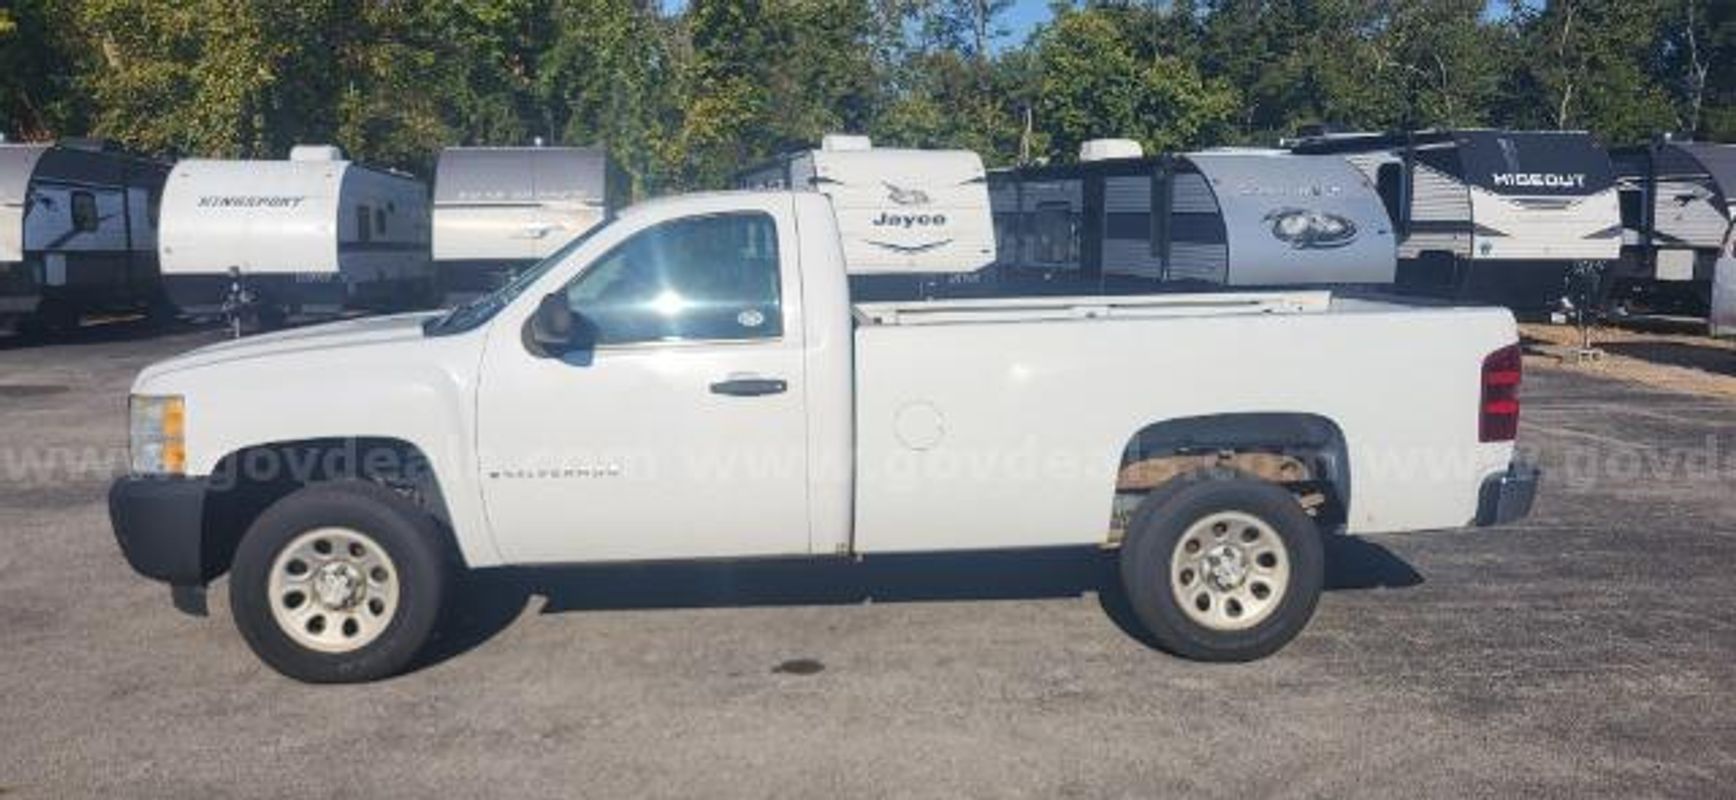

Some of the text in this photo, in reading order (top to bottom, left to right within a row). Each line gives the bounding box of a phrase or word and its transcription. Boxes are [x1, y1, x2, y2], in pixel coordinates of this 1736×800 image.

[1492, 173, 1586, 187] HIDEOUT
[198, 194, 304, 208] KINGSPORT
[872, 211, 946, 229] Jayco
